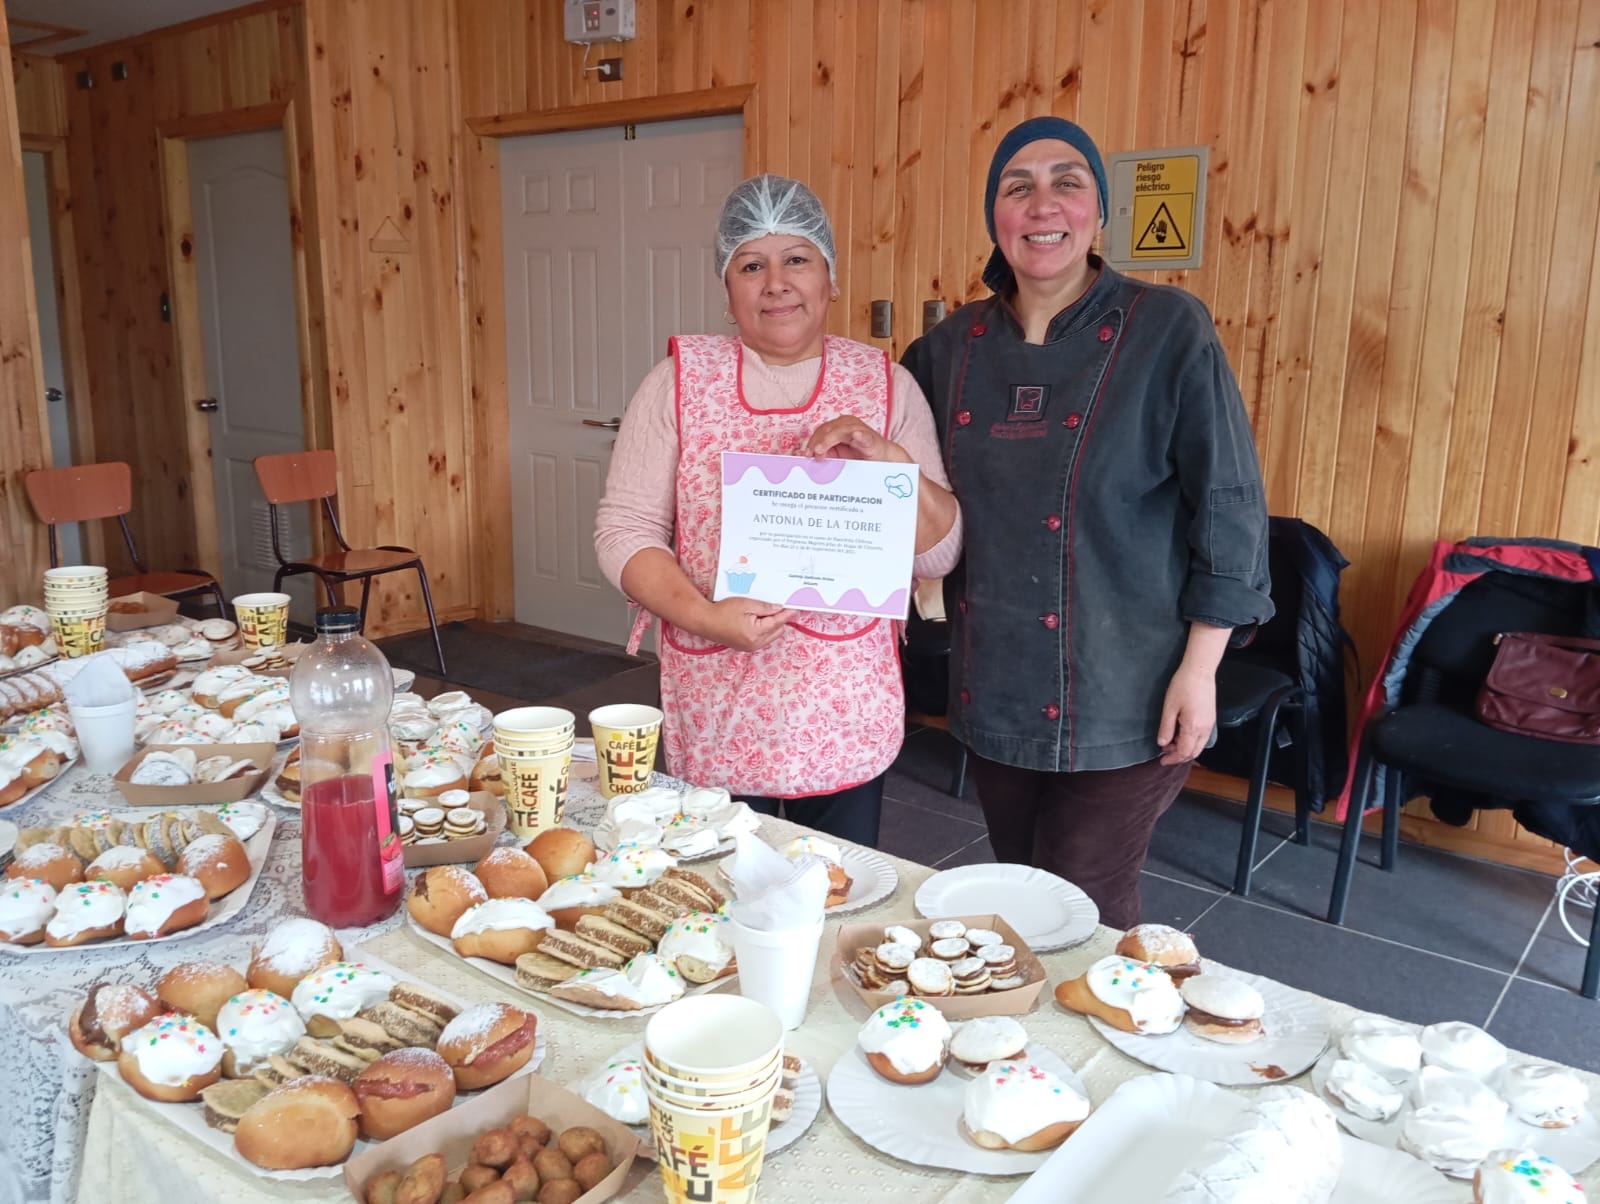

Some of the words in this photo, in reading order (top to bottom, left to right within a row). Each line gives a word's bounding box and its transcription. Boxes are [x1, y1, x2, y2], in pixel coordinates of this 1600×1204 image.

[1137, 162, 1165, 172] Peligro
[1136, 173, 1161, 182] riesgo
[1136, 183, 1170, 192] eléctrico
[752, 489, 806, 501] CERTIFICADO
[807, 492, 818, 501] DE
[819, 493, 883, 505] PARTICIPACION
[753, 513, 804, 527] ANTONIA
[807, 517, 823, 528] DE
[826, 518, 841, 529] LA
[844, 520, 882, 533] TORRE
[608, 739, 636, 750] CAFÉ
[517, 773, 539, 808] CAFÉ
[657, 1135, 710, 1178] AFÉ
